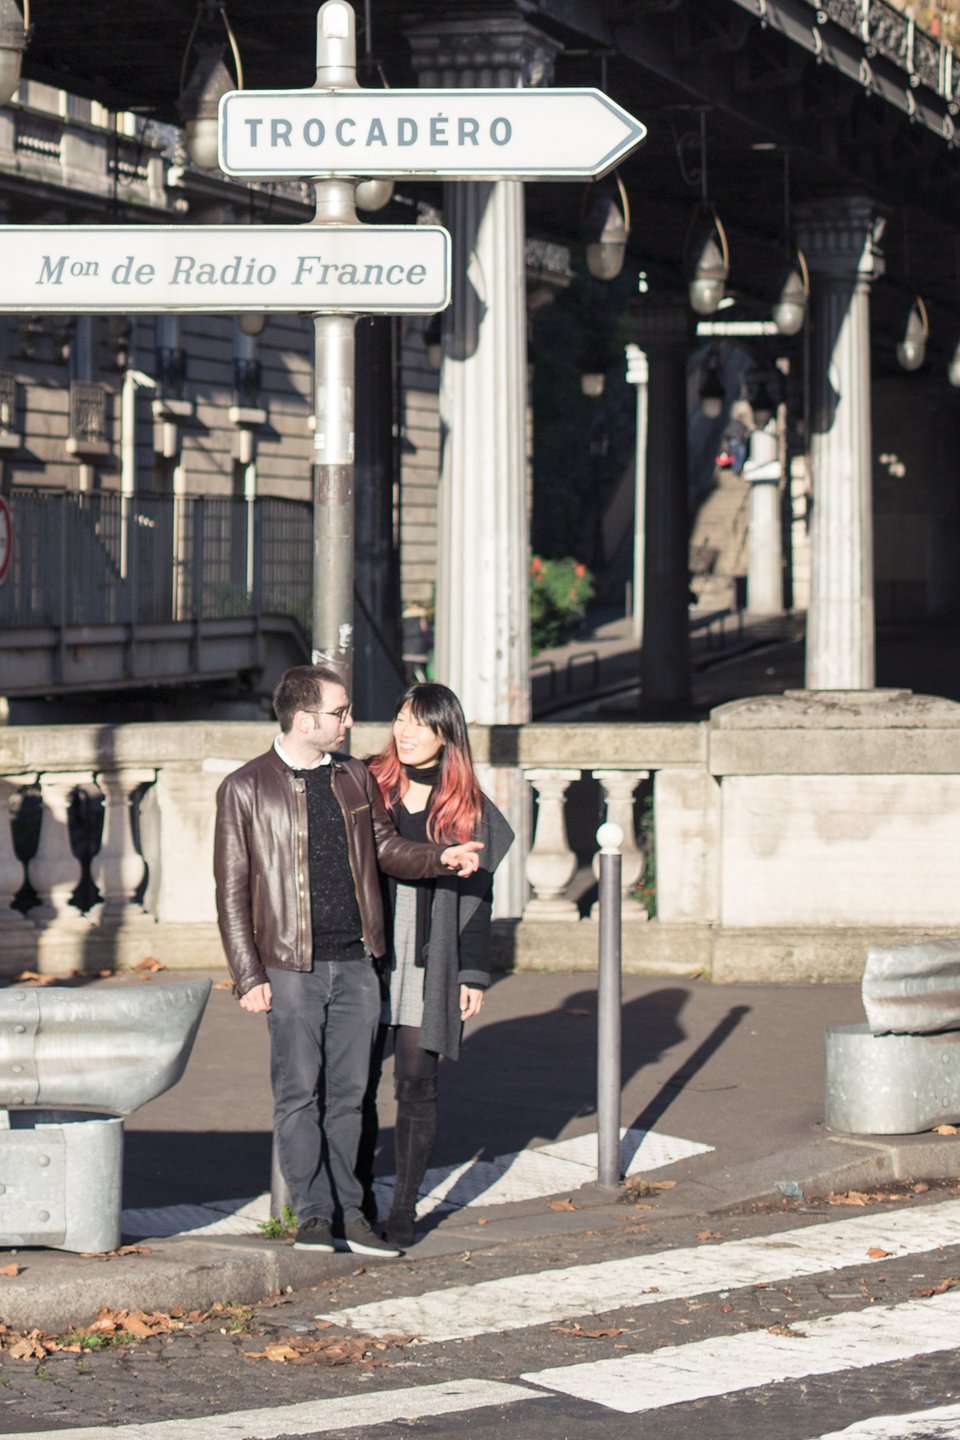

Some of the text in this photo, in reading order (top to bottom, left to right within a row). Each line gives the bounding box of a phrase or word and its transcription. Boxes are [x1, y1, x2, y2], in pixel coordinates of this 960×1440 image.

[244, 112, 513, 148] TROCADÉRO
[35, 255, 427, 286] Mon de Radio France
